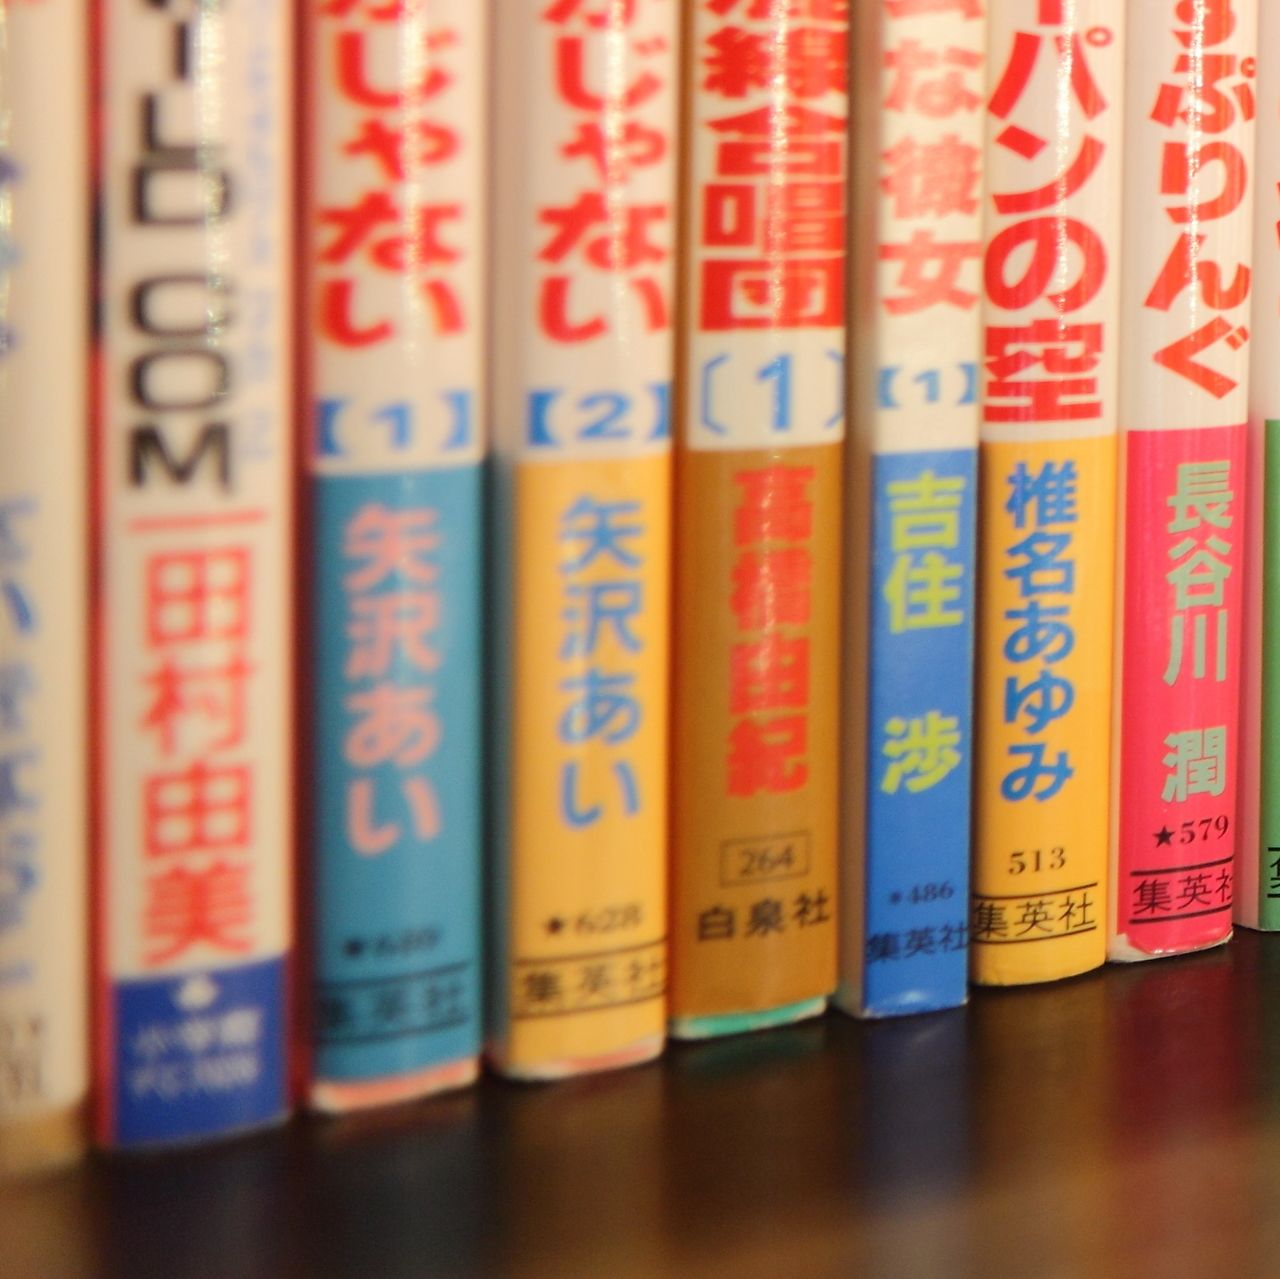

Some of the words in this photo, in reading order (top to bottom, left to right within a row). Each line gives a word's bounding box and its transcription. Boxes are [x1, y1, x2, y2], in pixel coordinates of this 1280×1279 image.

[127, 275, 233, 490] COM
[525, 381, 672, 448] 【2】
[877, 361, 978, 411] 【1】
[317, 389, 472, 458] 【1】
[884, 469, 966, 635] 吉住
[1162, 461, 1235, 687] 長谷川
[556, 494, 644, 832] 矢沢あい
[1001, 459, 1079, 803] 椎名あゆみ
[344, 502, 442, 856] 矢沢あい
[142, 546, 255, 968] 田村由美
[881, 711, 962, 794] 渉
[1161, 726, 1227, 803] 潤
[1008, 848, 1067, 876] 513
[1180, 815, 1230, 846] 579
[697, 888, 830, 943] 白泉社
[868, 920, 970, 963] 集英社
[974, 892, 1098, 939] 集英社
